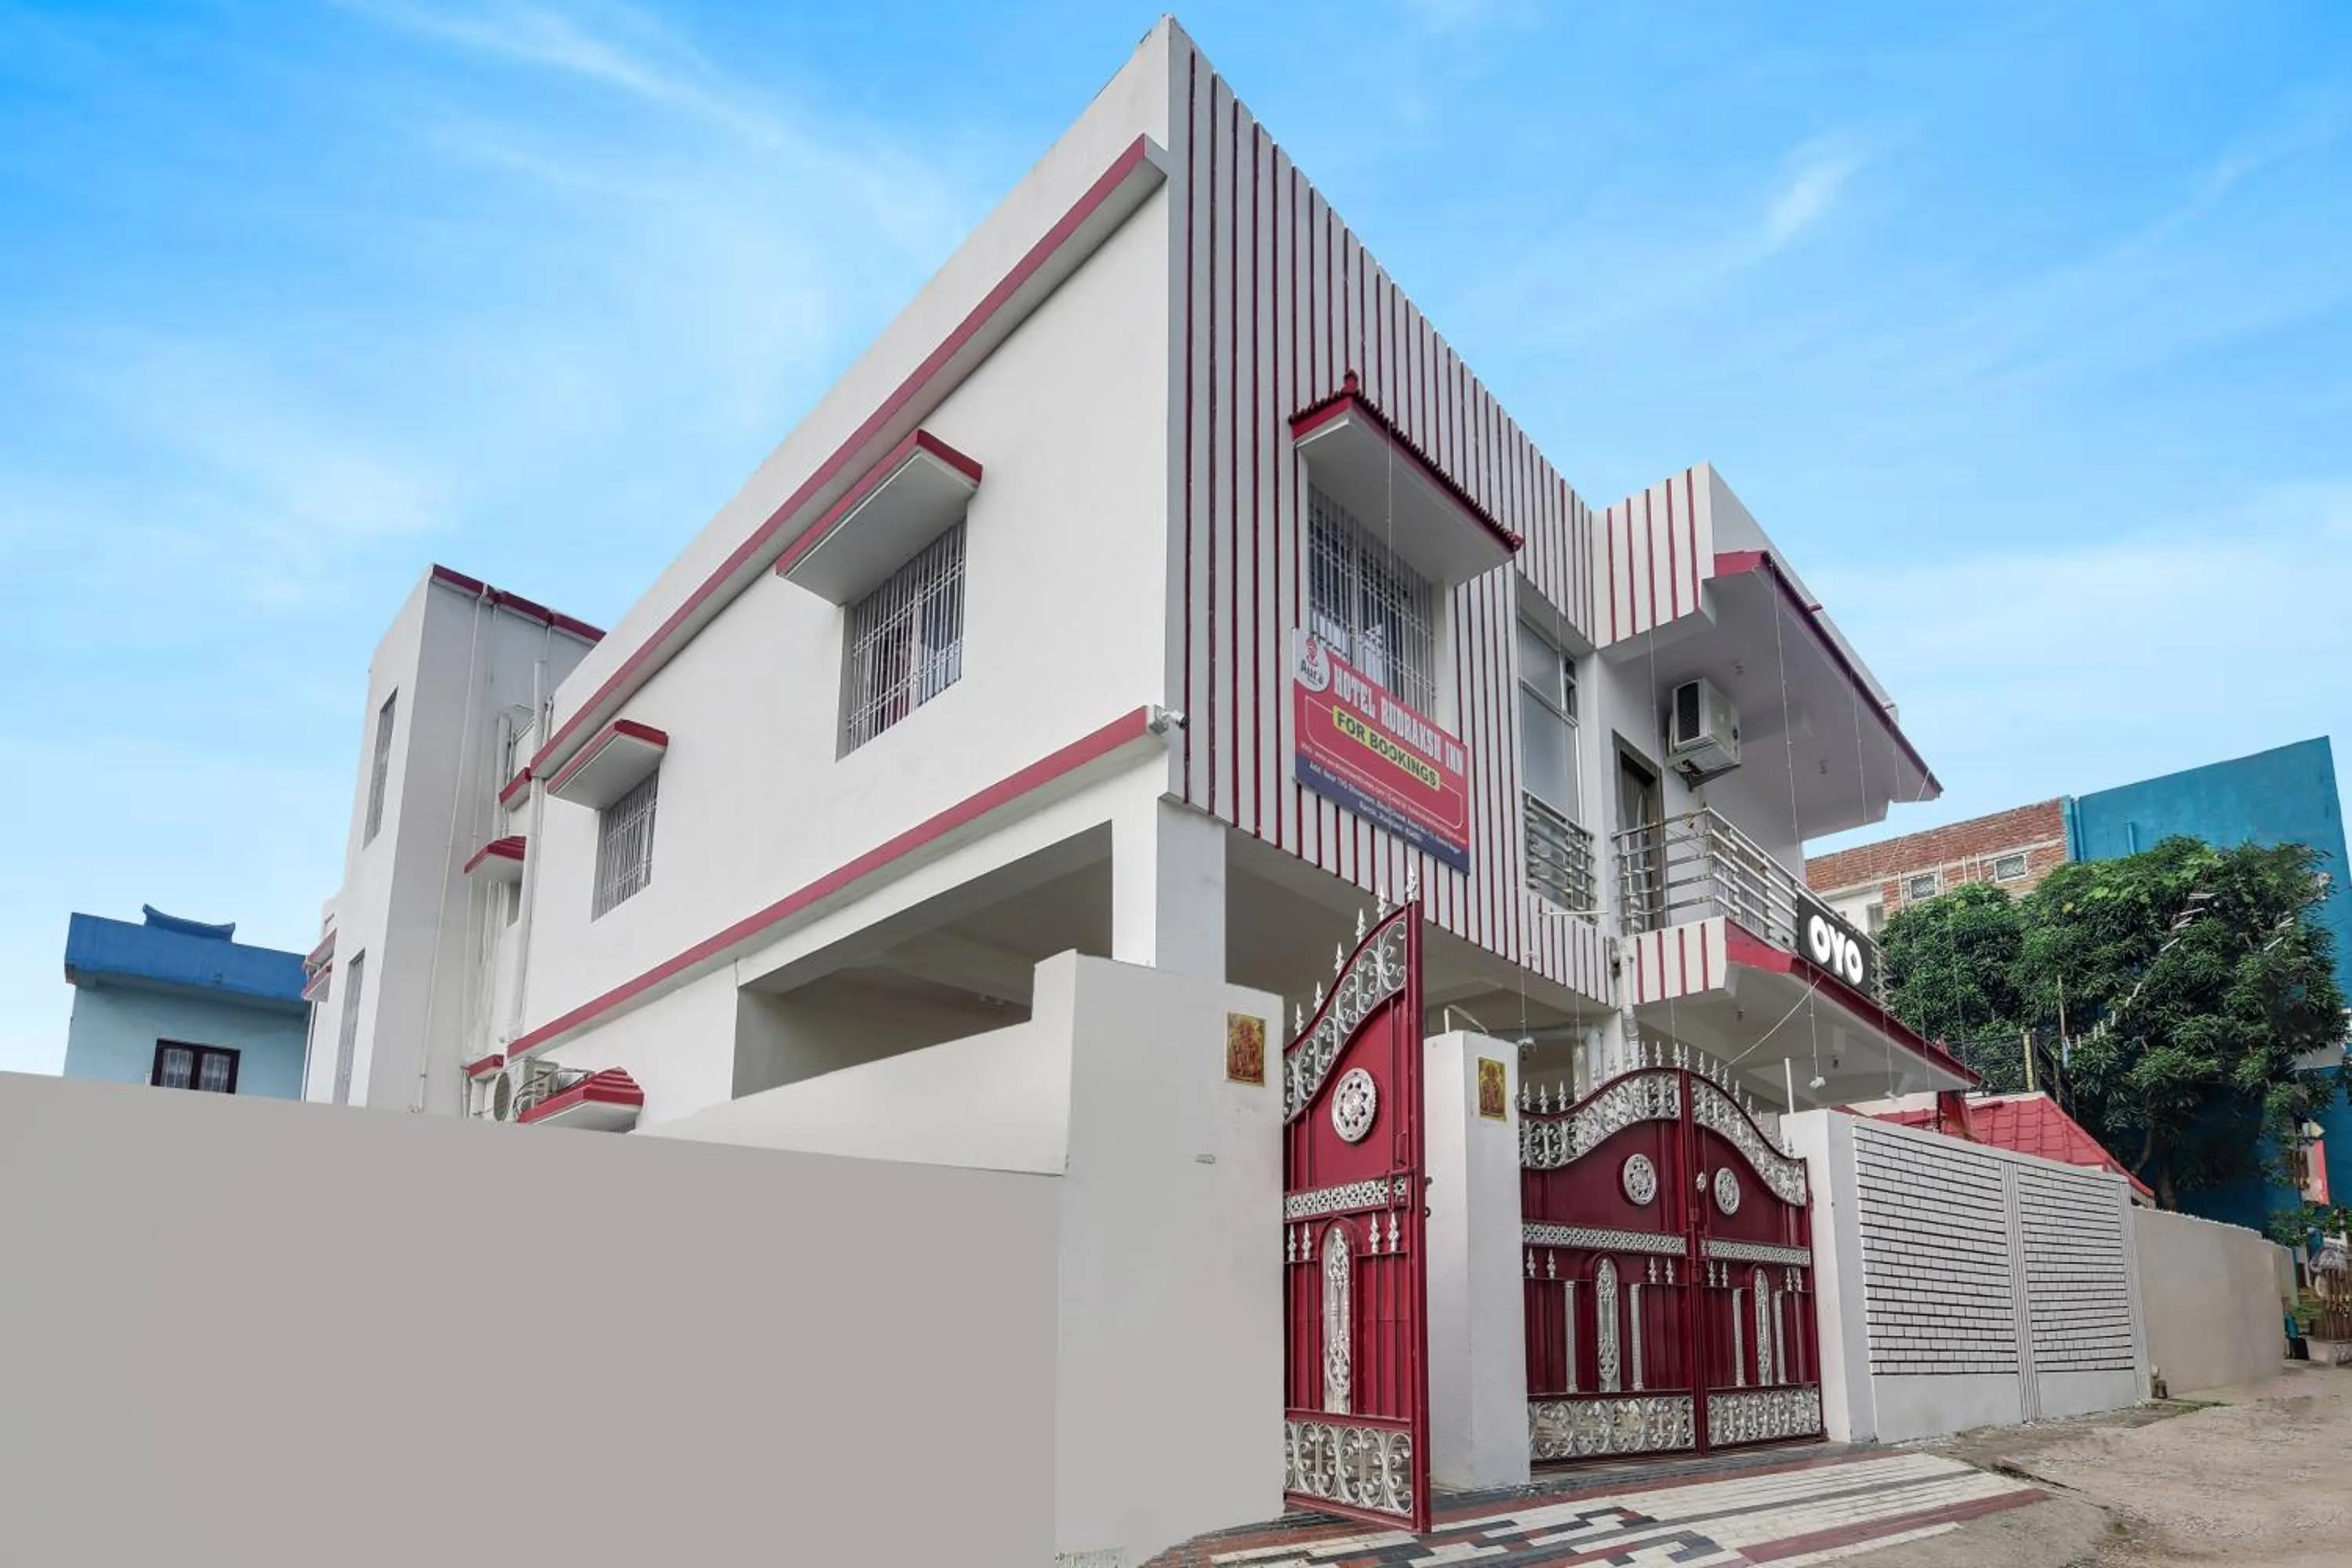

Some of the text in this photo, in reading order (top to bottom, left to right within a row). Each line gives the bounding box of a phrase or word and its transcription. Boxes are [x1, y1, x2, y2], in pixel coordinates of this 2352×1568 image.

[1334, 663, 1375, 719] HOTEL
[1381, 695, 1442, 763] RUDRAKSH
[1446, 741, 1464, 779] INN
[1337, 710, 1366, 742] FOR
[1370, 732, 1436, 786] BOOKINGS
[1808, 914, 1864, 986] OYO
